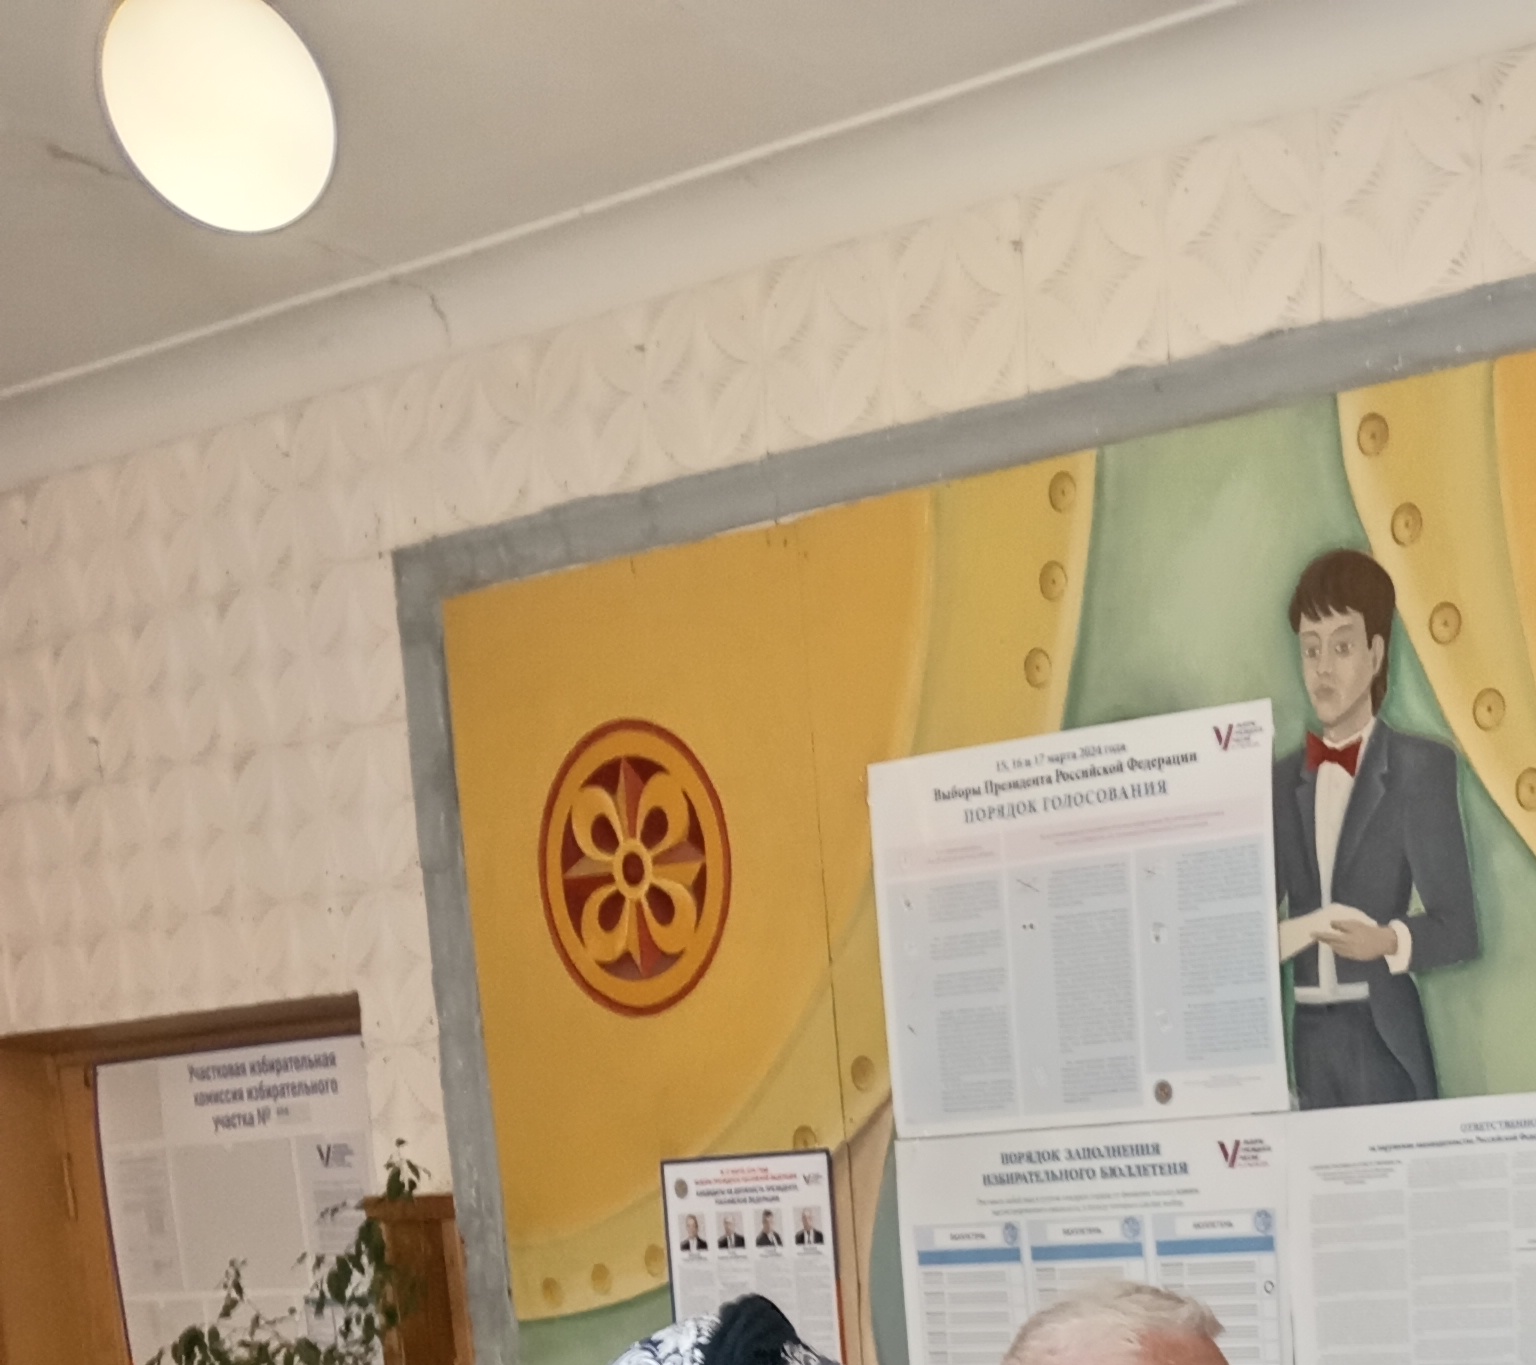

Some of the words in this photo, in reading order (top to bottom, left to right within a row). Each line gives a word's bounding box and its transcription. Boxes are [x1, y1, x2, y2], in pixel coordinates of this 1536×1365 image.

[933, 782, 982, 803] Выборы
[984, 773, 1053, 796] Президента
[1055, 760, 1124, 784] Российской
[1126, 750, 1198, 773] Федерации
[963, 797, 1038, 824] ПОРЯДОК
[1041, 779, 1169, 812] ГОЛОСОВАНИЯ
[999, 1147, 1061, 1166] ПОРЯДОК
[1063, 1142, 1163, 1163] ЗАПОЛНЕНИЯ
[982, 1167, 1096, 1187] ИЗБИРАТЕЛЬНОГО
